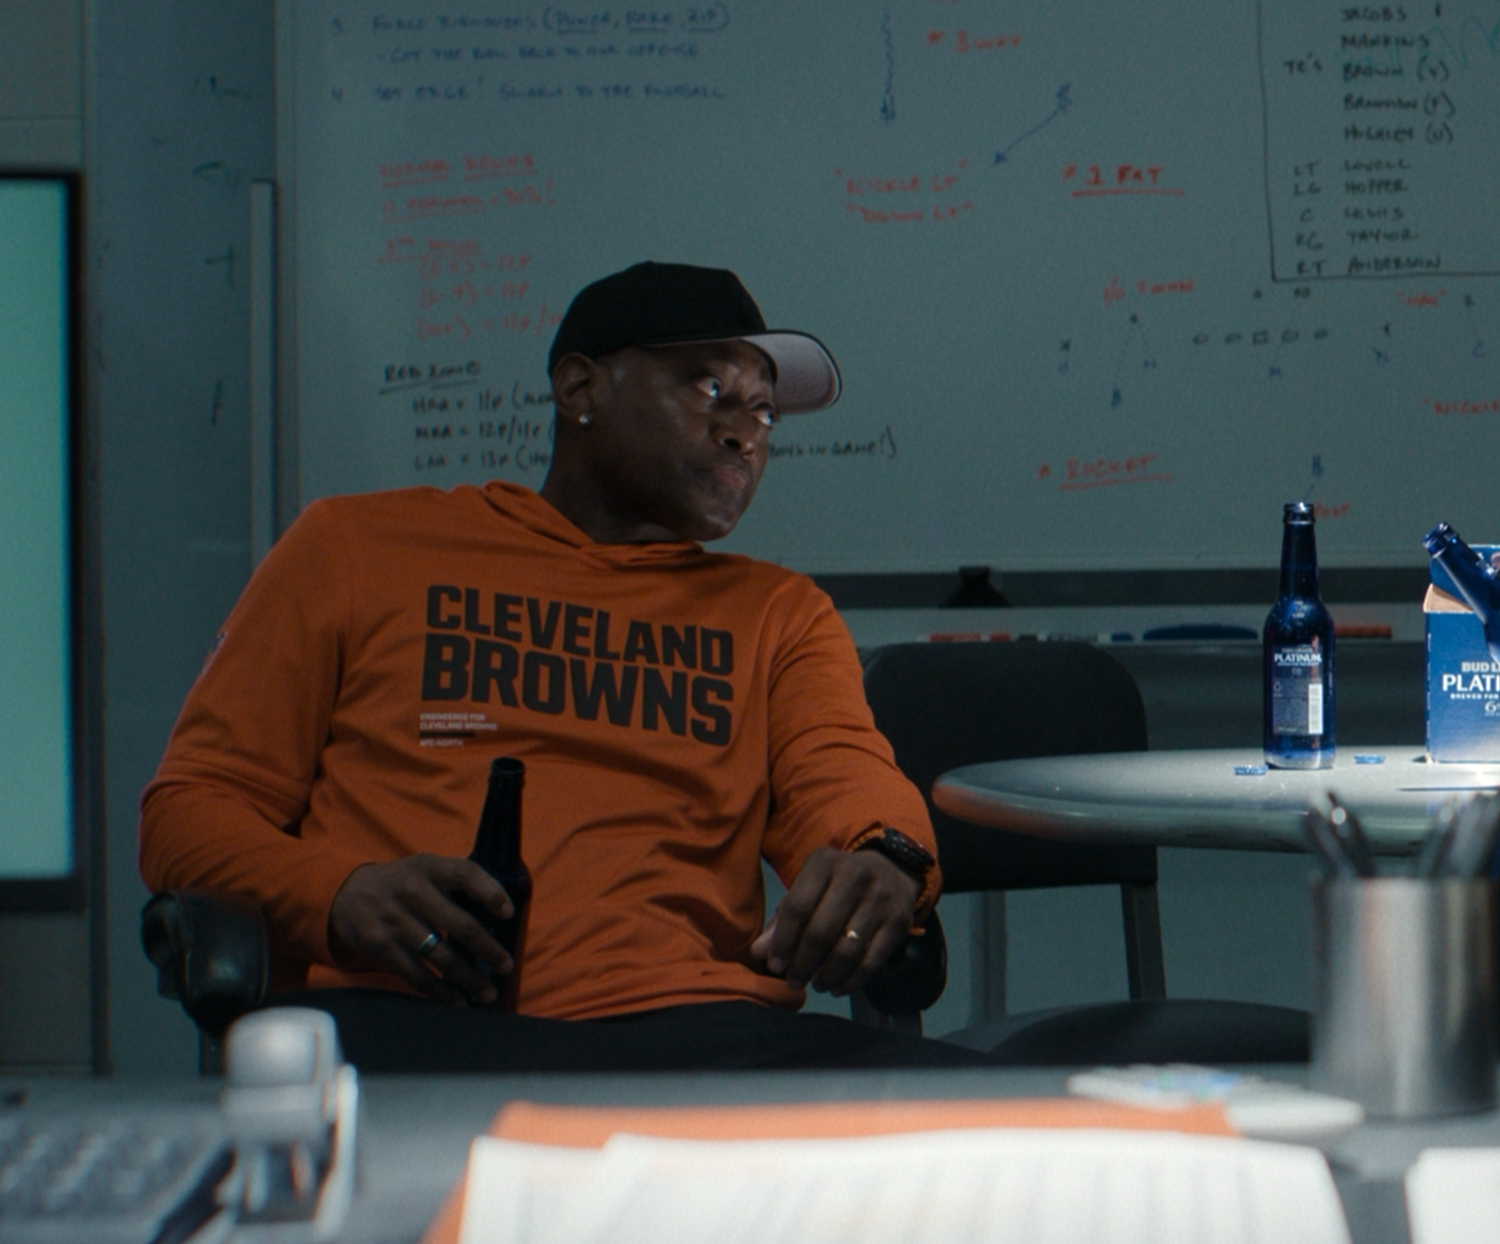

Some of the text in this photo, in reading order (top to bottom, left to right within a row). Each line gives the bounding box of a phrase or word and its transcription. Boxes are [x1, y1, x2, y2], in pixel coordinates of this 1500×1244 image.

[1343, 62, 1403, 82] BROWN
[1294, 161, 1319, 176] LT
[1345, 178, 1408, 194] HOPPER
[1300, 207, 1404, 222] C LEWIS
[1347, 227, 1416, 245] TAYLOR
[1348, 254, 1442, 275] ANDERSON
[385, 365, 421, 382] RED
[427, 585, 733, 676] CLEVELAND
[1461, 661, 1490, 673] BUD
[421, 632, 733, 747] BROWNS
[420, 712, 486, 721] ENGINEERED FOR
[420, 721, 499, 731] CLEVELAND BROWNS
